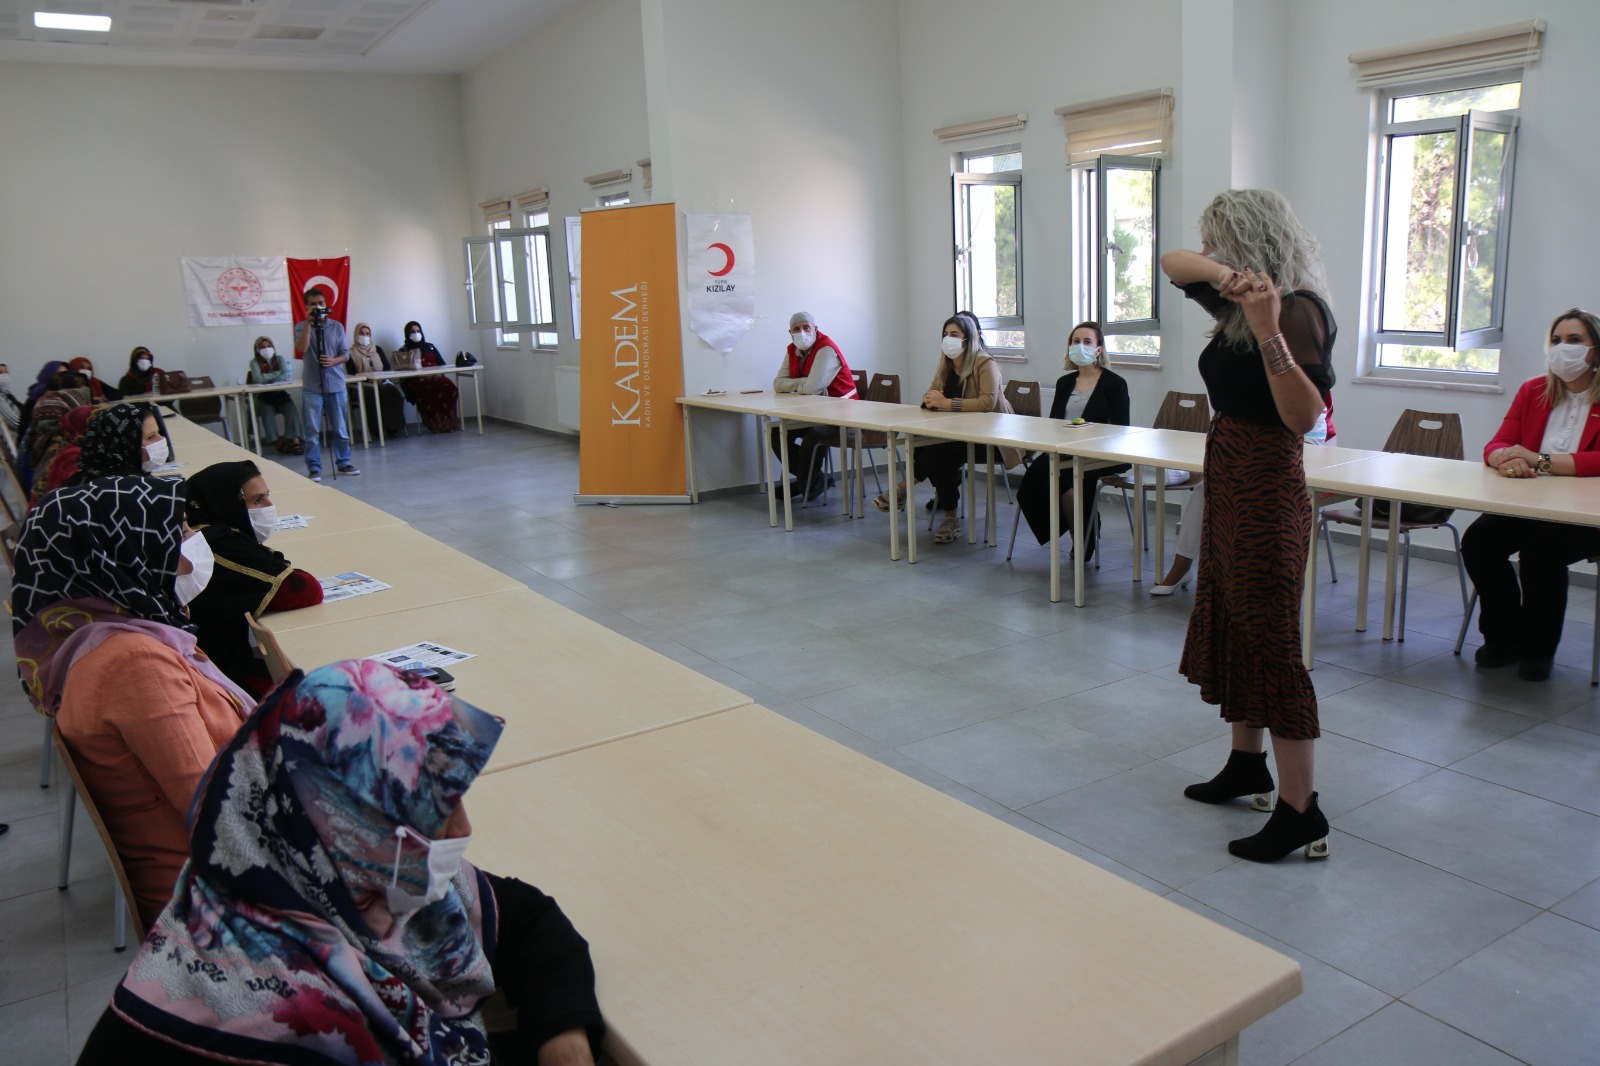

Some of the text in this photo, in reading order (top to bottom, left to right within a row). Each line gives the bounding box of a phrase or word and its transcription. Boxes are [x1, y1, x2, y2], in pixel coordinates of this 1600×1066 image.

[706, 284, 736, 293] KIZILAY
[611, 282, 641, 427] KADEM
[642, 326, 650, 380] DEMOKRASİ
[644, 384, 651, 396] VE
